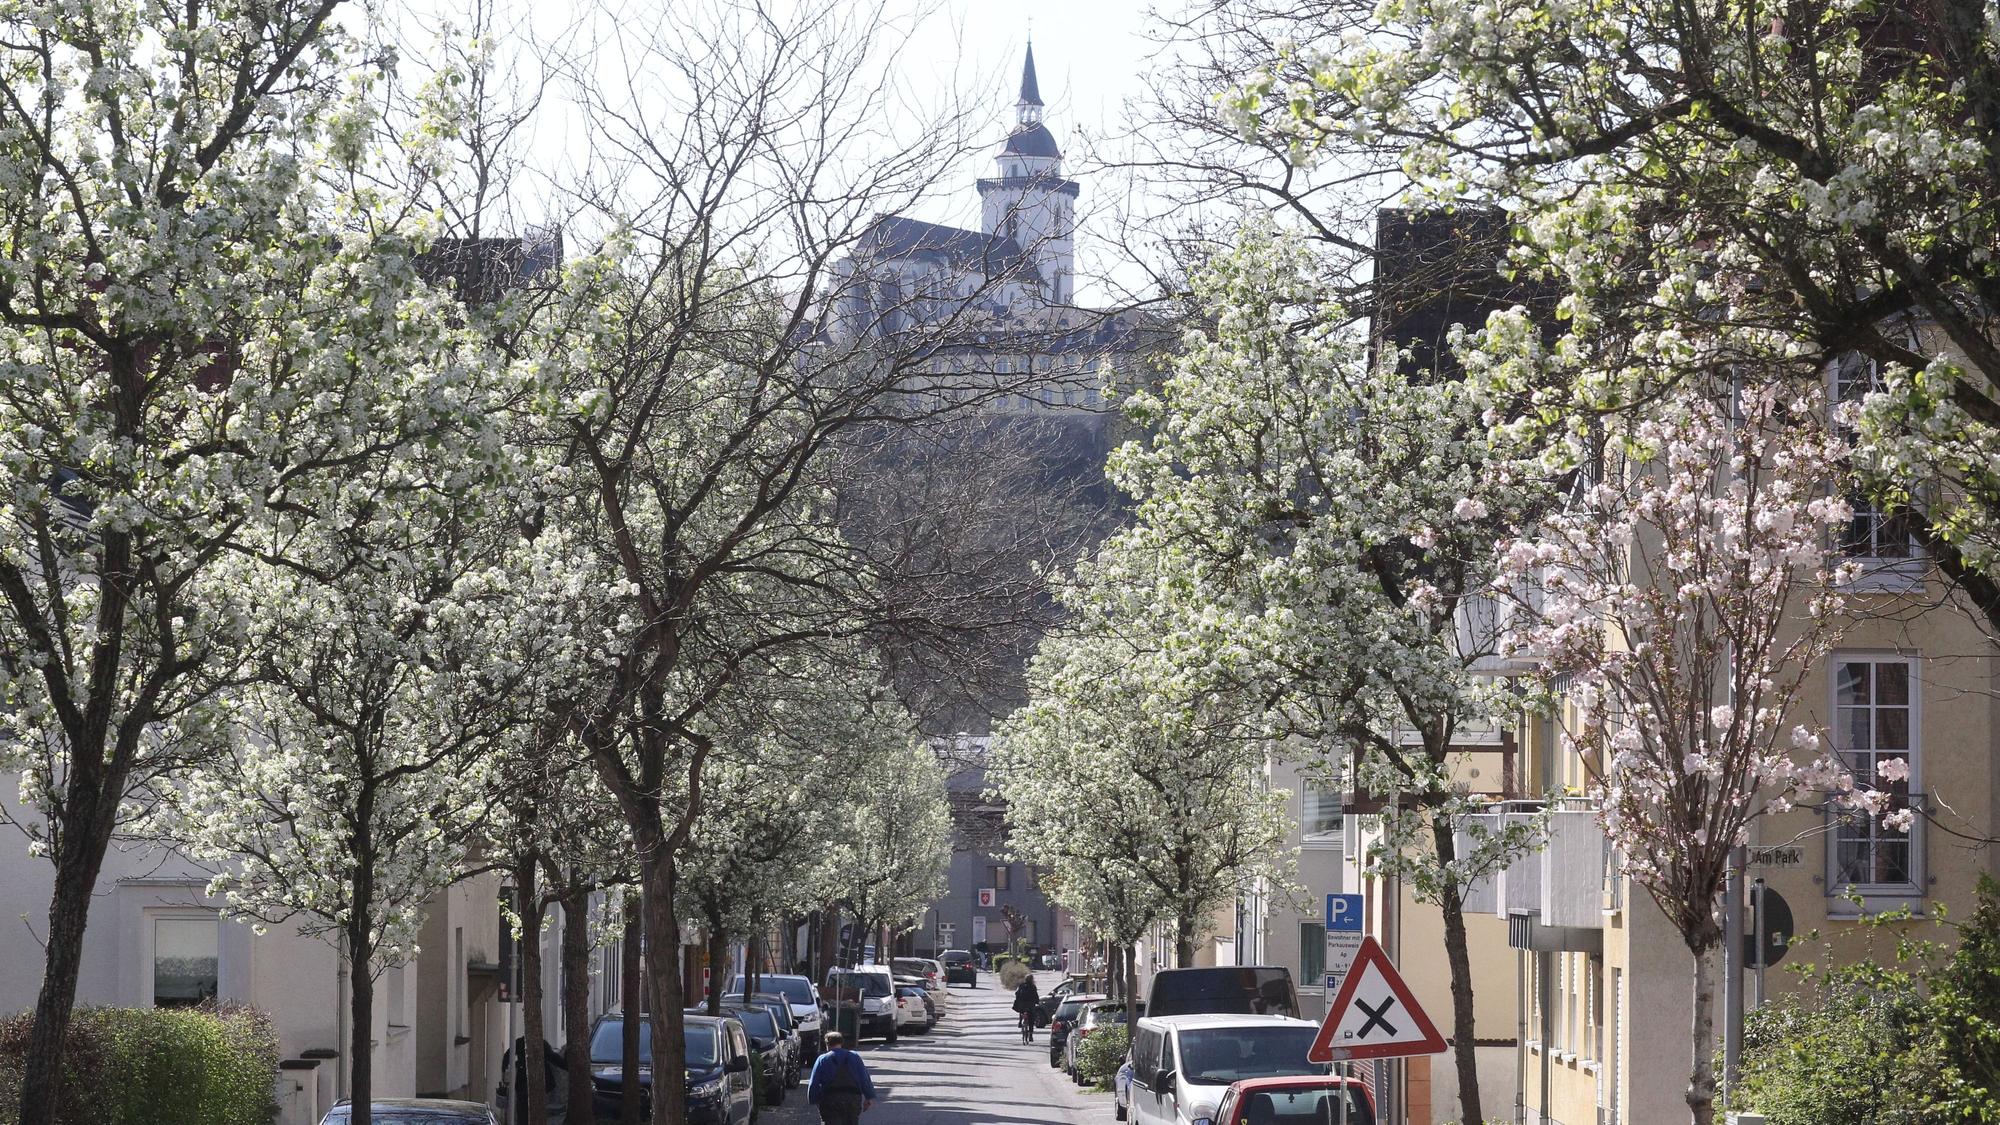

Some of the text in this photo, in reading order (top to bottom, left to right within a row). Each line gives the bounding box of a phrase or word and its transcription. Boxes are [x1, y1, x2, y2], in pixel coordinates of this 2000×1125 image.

[1755, 850, 1799, 864] Am Park
[1332, 898, 1348, 923] P
